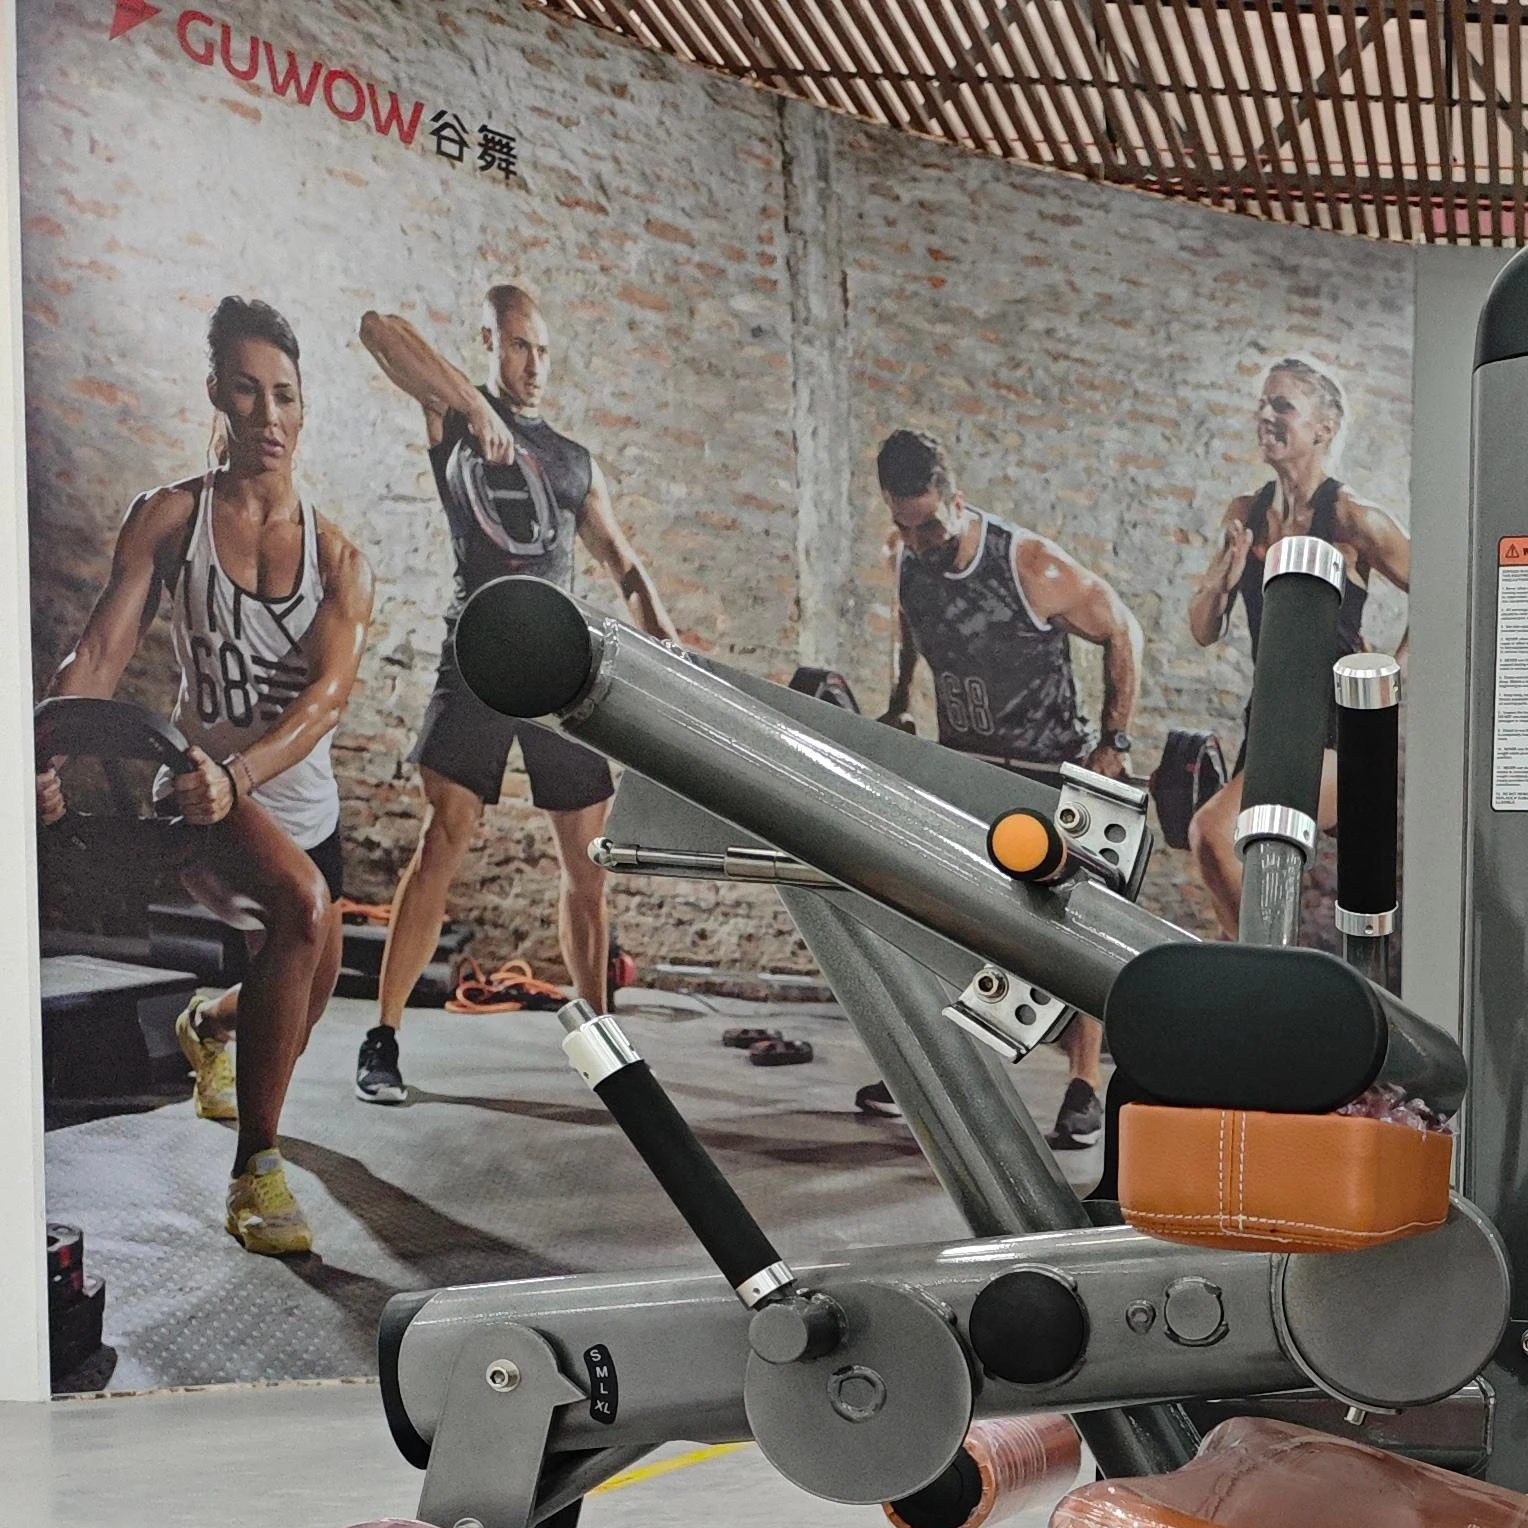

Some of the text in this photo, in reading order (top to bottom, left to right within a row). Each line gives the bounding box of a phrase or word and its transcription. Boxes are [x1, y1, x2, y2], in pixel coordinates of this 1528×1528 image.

[176, 9, 518, 180] GUWOW 谷舞
[590, 1349, 601, 1361] S
[596, 1366, 608, 1378] M
[600, 1382, 608, 1394] L
[594, 1400, 611, 1414] XL
